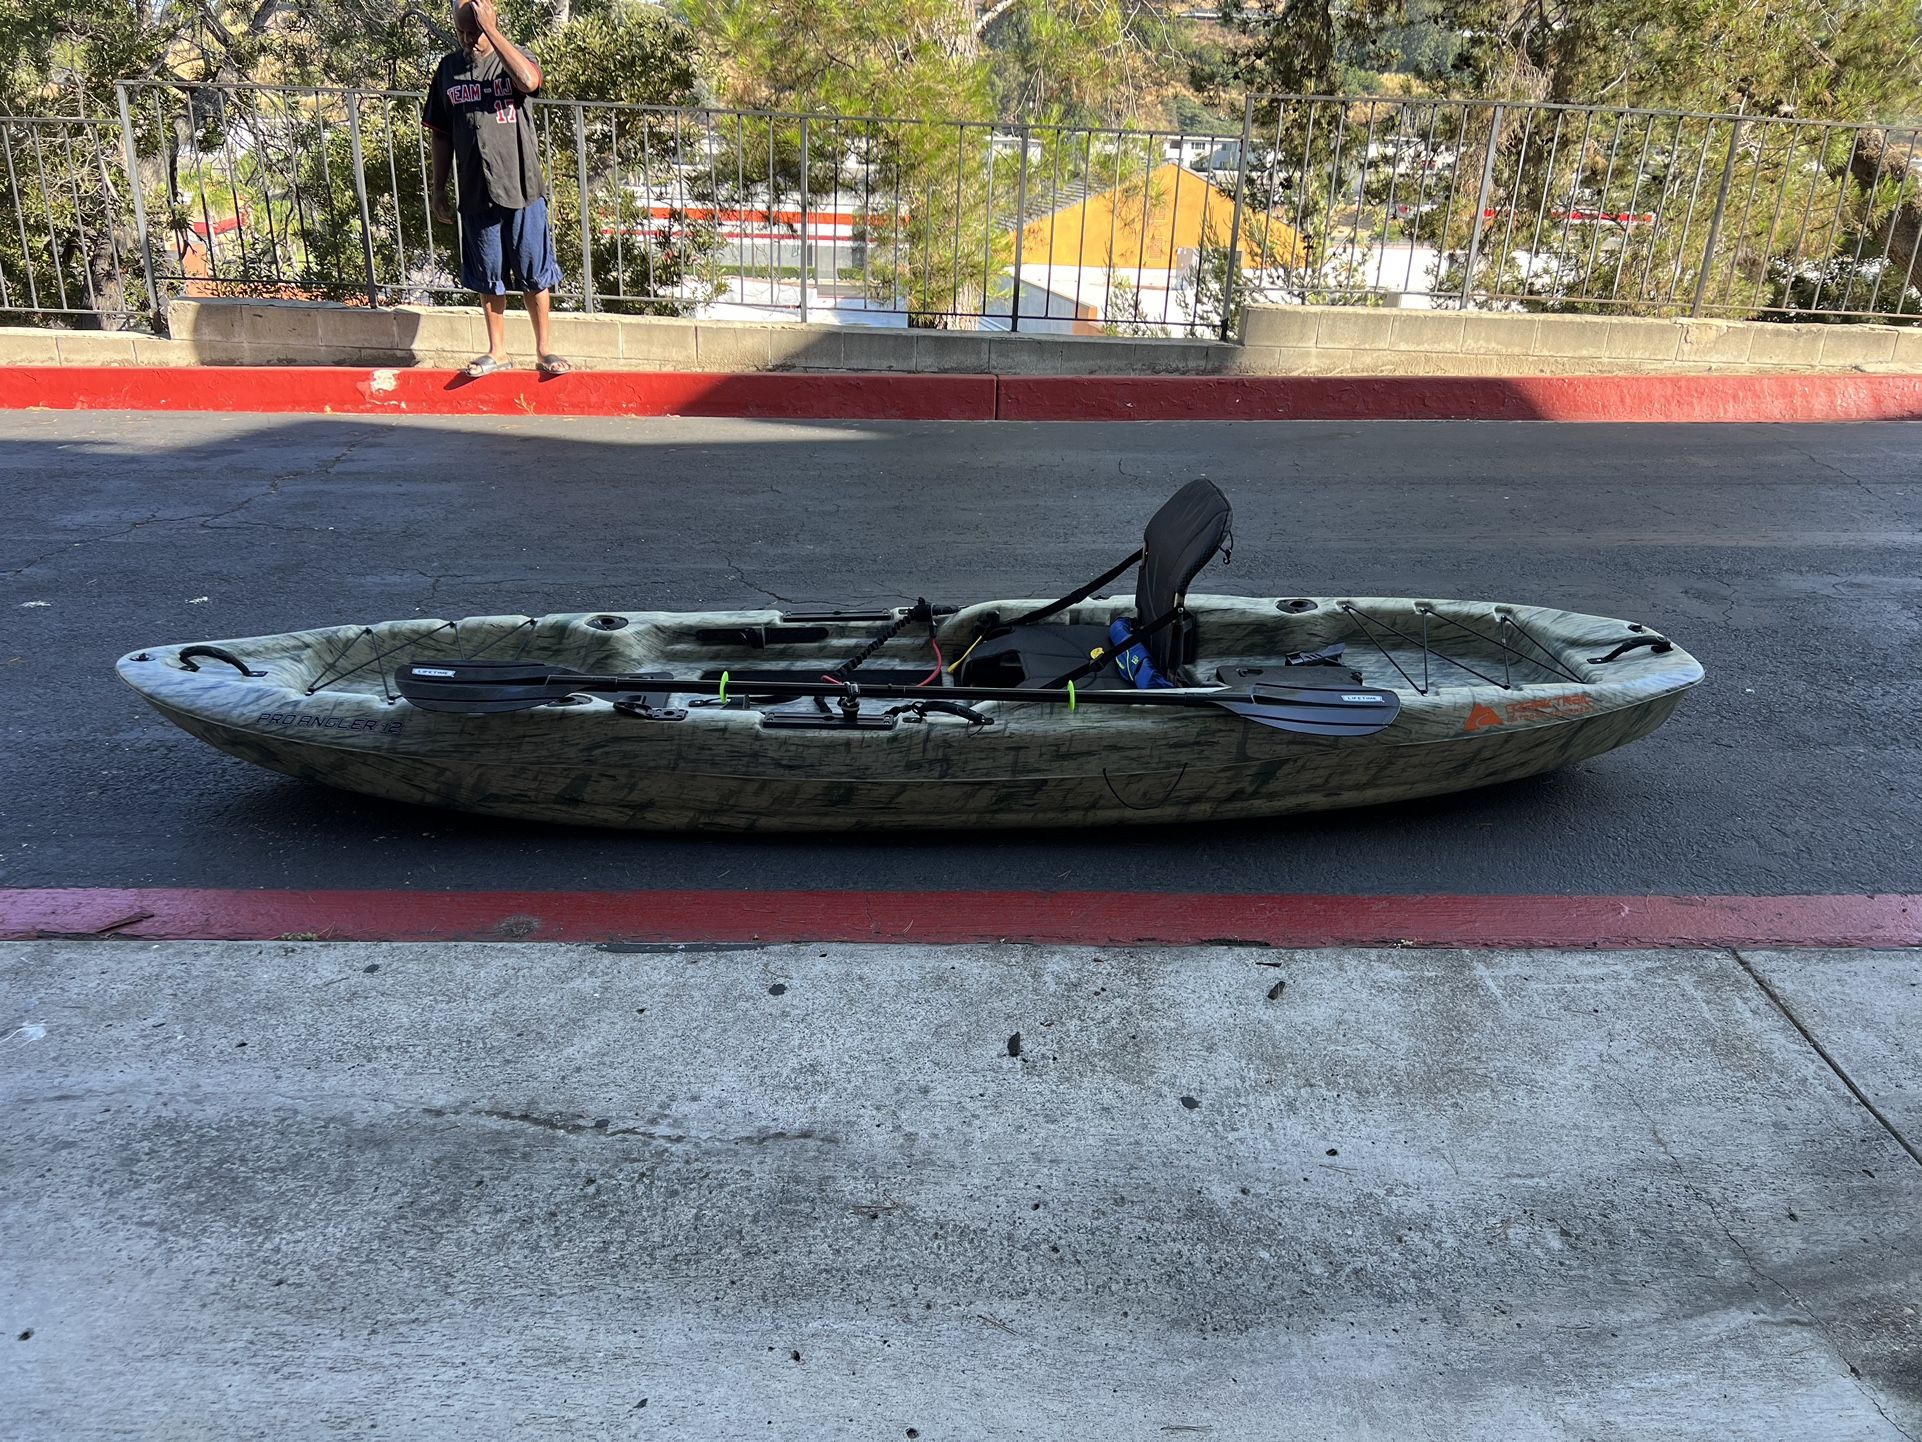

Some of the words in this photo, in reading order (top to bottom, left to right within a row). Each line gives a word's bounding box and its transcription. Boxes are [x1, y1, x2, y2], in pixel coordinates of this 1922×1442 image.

[447, 83, 482, 106] TEAM
[494, 99, 517, 124] 17
[257, 712, 297, 726] PRO
[297, 714, 378, 732] ANGLER
[380, 720, 404, 735] 12
